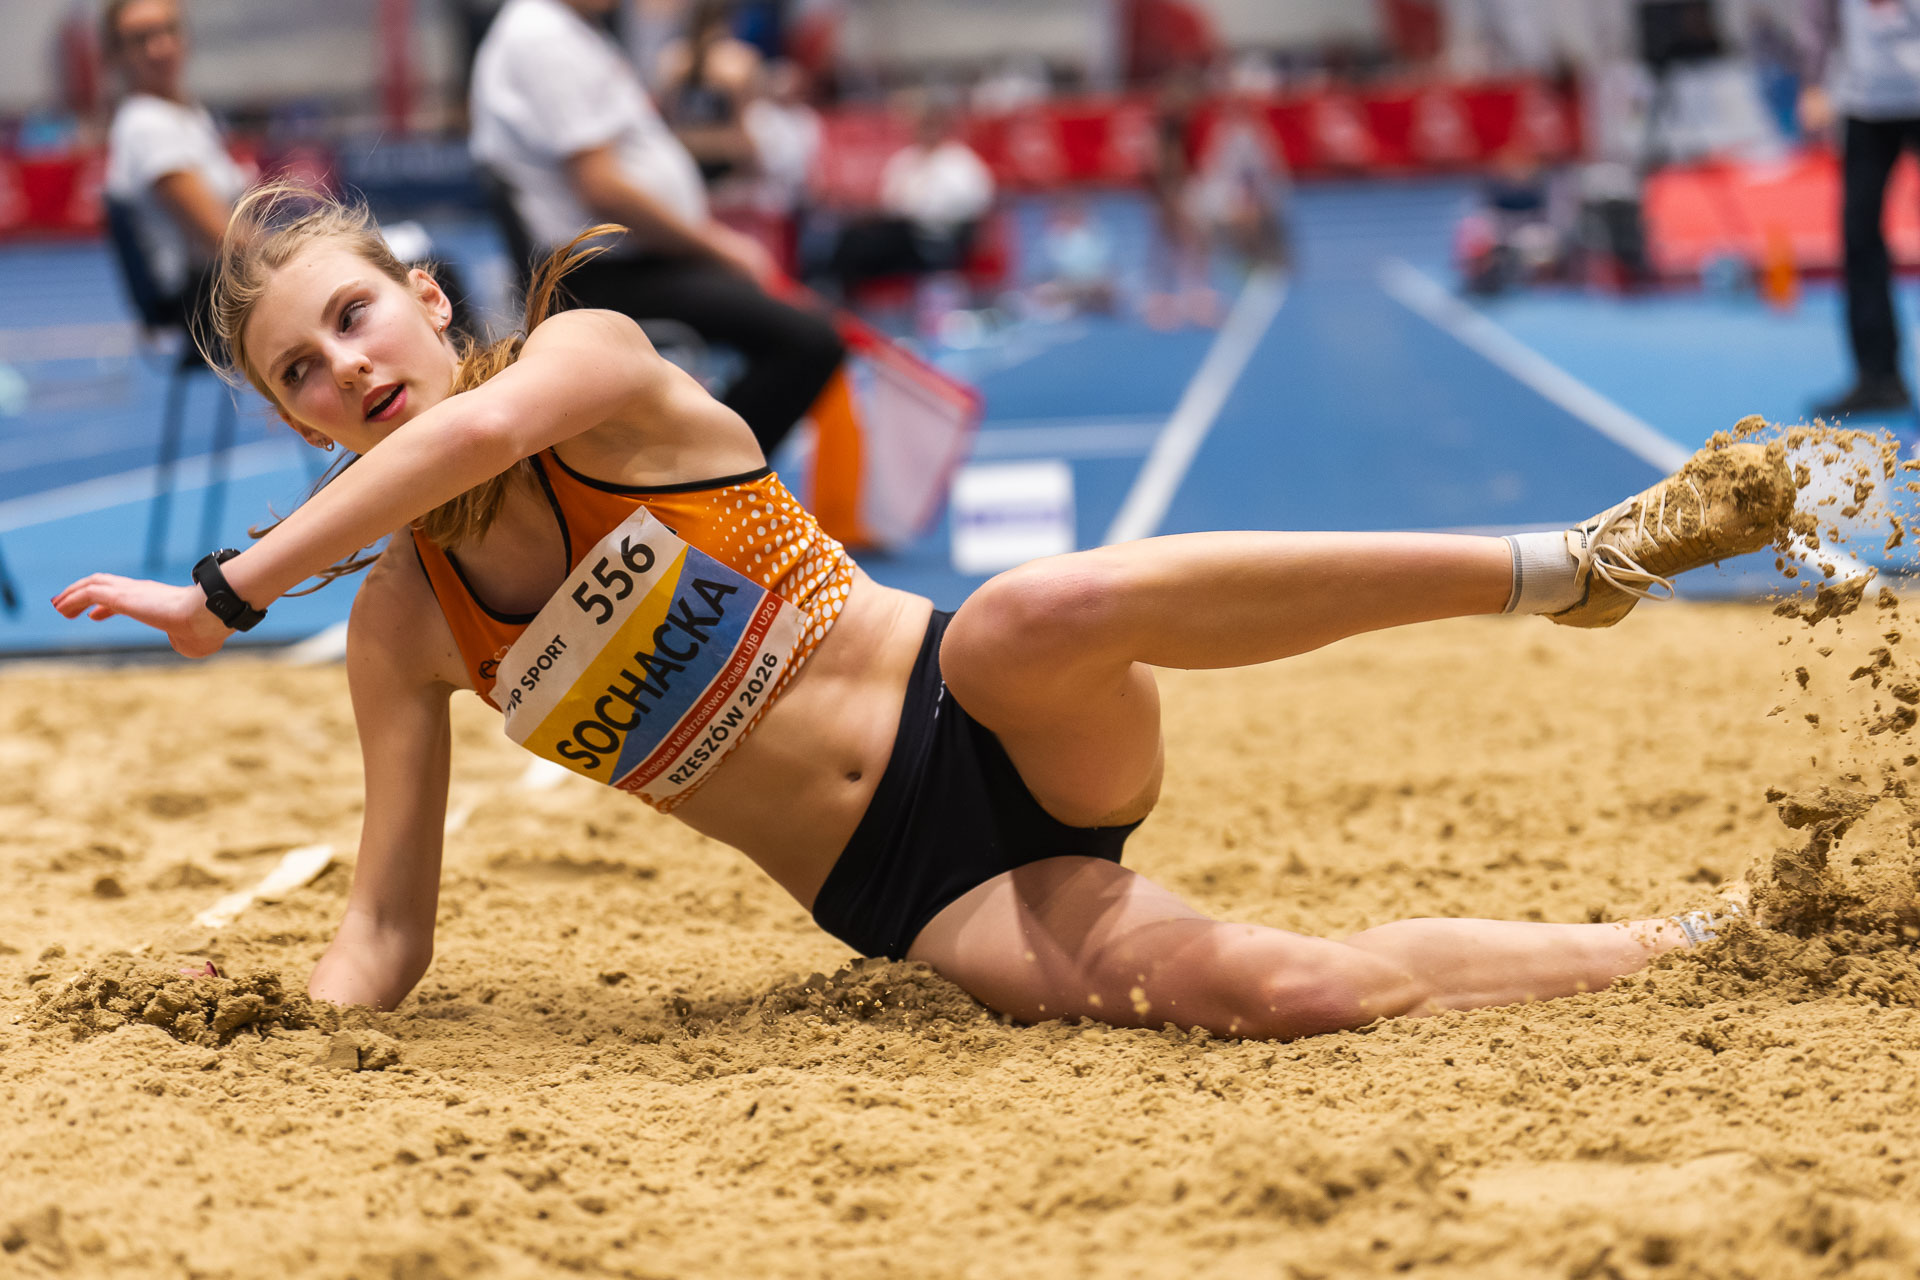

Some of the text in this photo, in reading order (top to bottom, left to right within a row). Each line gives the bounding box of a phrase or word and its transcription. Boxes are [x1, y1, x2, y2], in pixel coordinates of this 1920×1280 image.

[572, 535, 656, 625] 556
[520, 634, 568, 691] SPORT
[556, 578, 738, 769] SOCHACKA
[641, 746, 677, 778] Halowe
[672, 690, 726, 748] Mistrzostwa
[721, 655, 748, 690] Polski
[743, 633, 760, 655] U18
[757, 601, 777, 626] U20
[667, 653, 778, 785] RZESZÓW 2026
